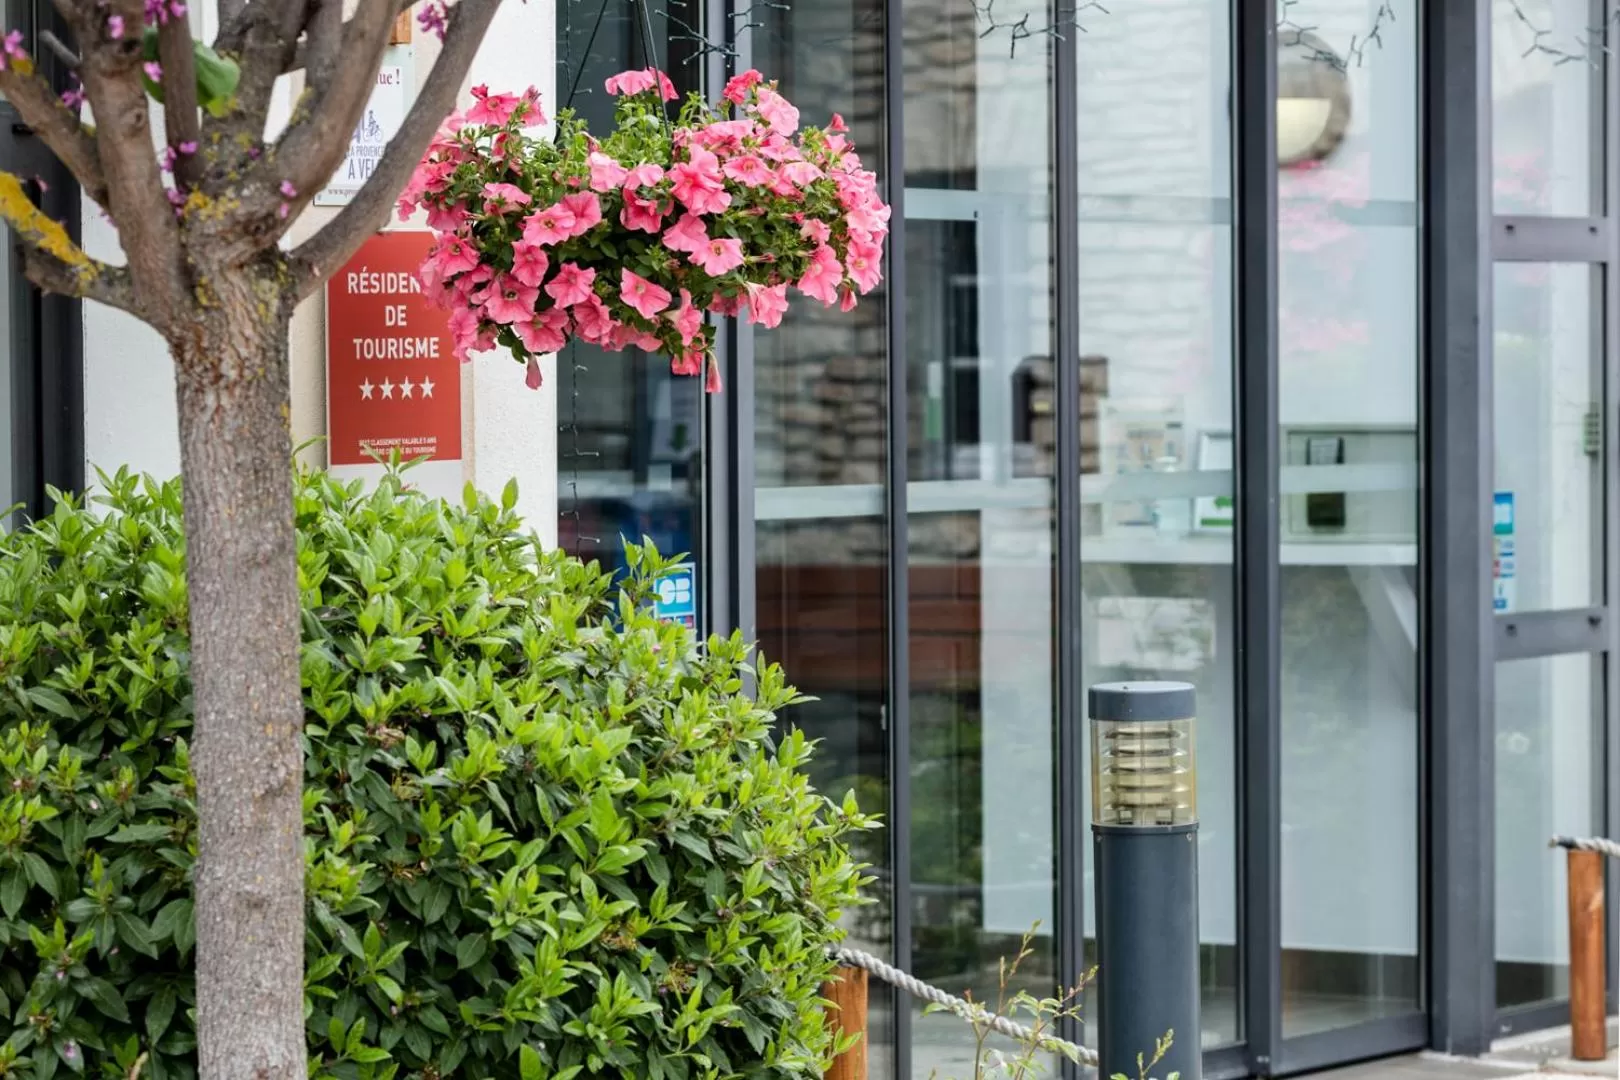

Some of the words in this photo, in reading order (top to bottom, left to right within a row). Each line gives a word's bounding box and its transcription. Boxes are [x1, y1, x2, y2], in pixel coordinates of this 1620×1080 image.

[347, 266, 421, 294] RÉSIDEN
[385, 305, 407, 326] DE
[353, 337, 440, 359] TOURISME
